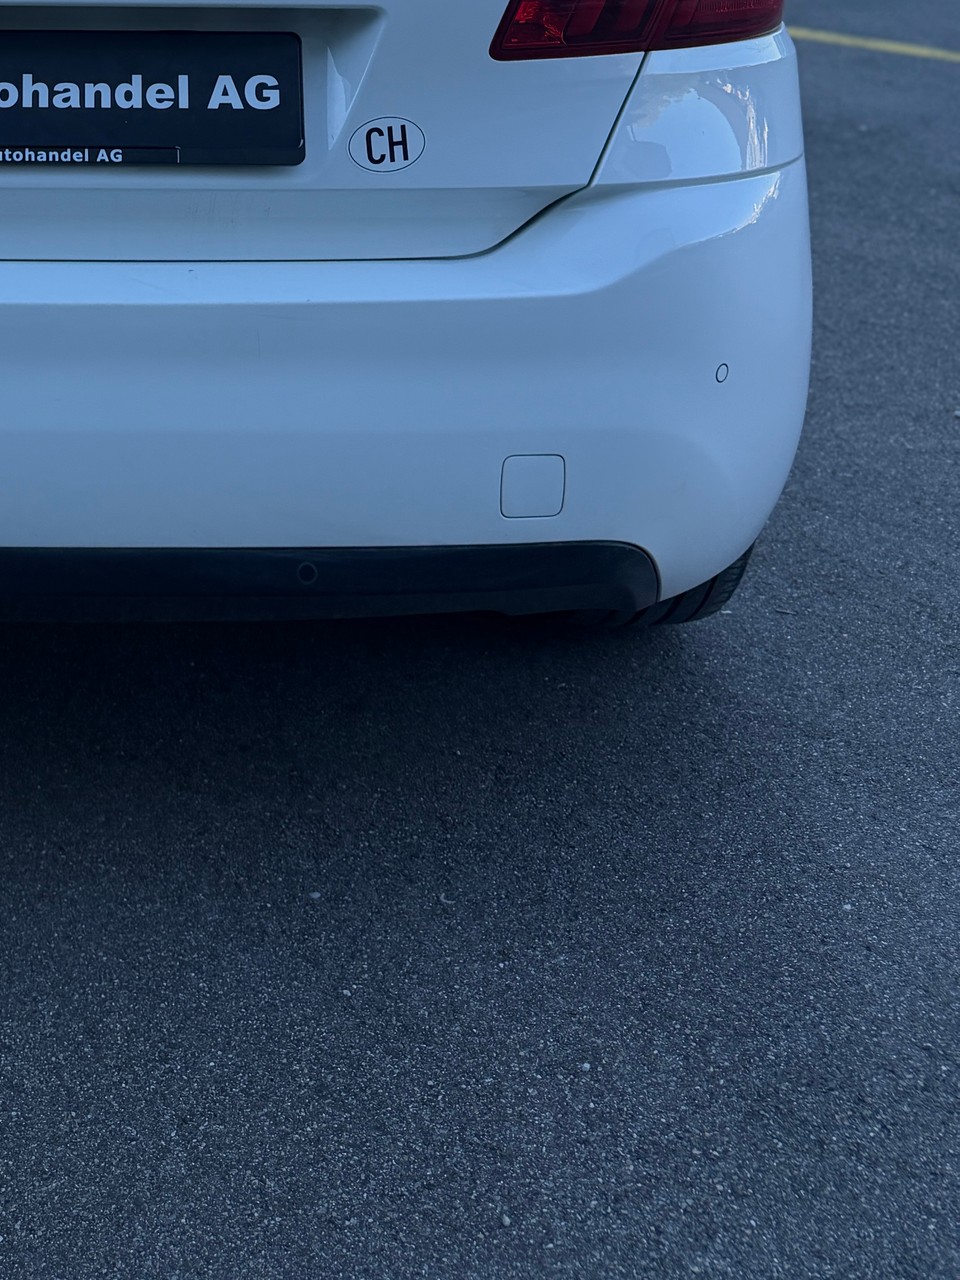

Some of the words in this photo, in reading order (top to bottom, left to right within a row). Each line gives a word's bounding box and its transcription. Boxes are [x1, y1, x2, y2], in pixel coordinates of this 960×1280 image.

[207, 73, 281, 110] AG
[95, 148, 123, 163] AG
[365, 123, 409, 166] CH
